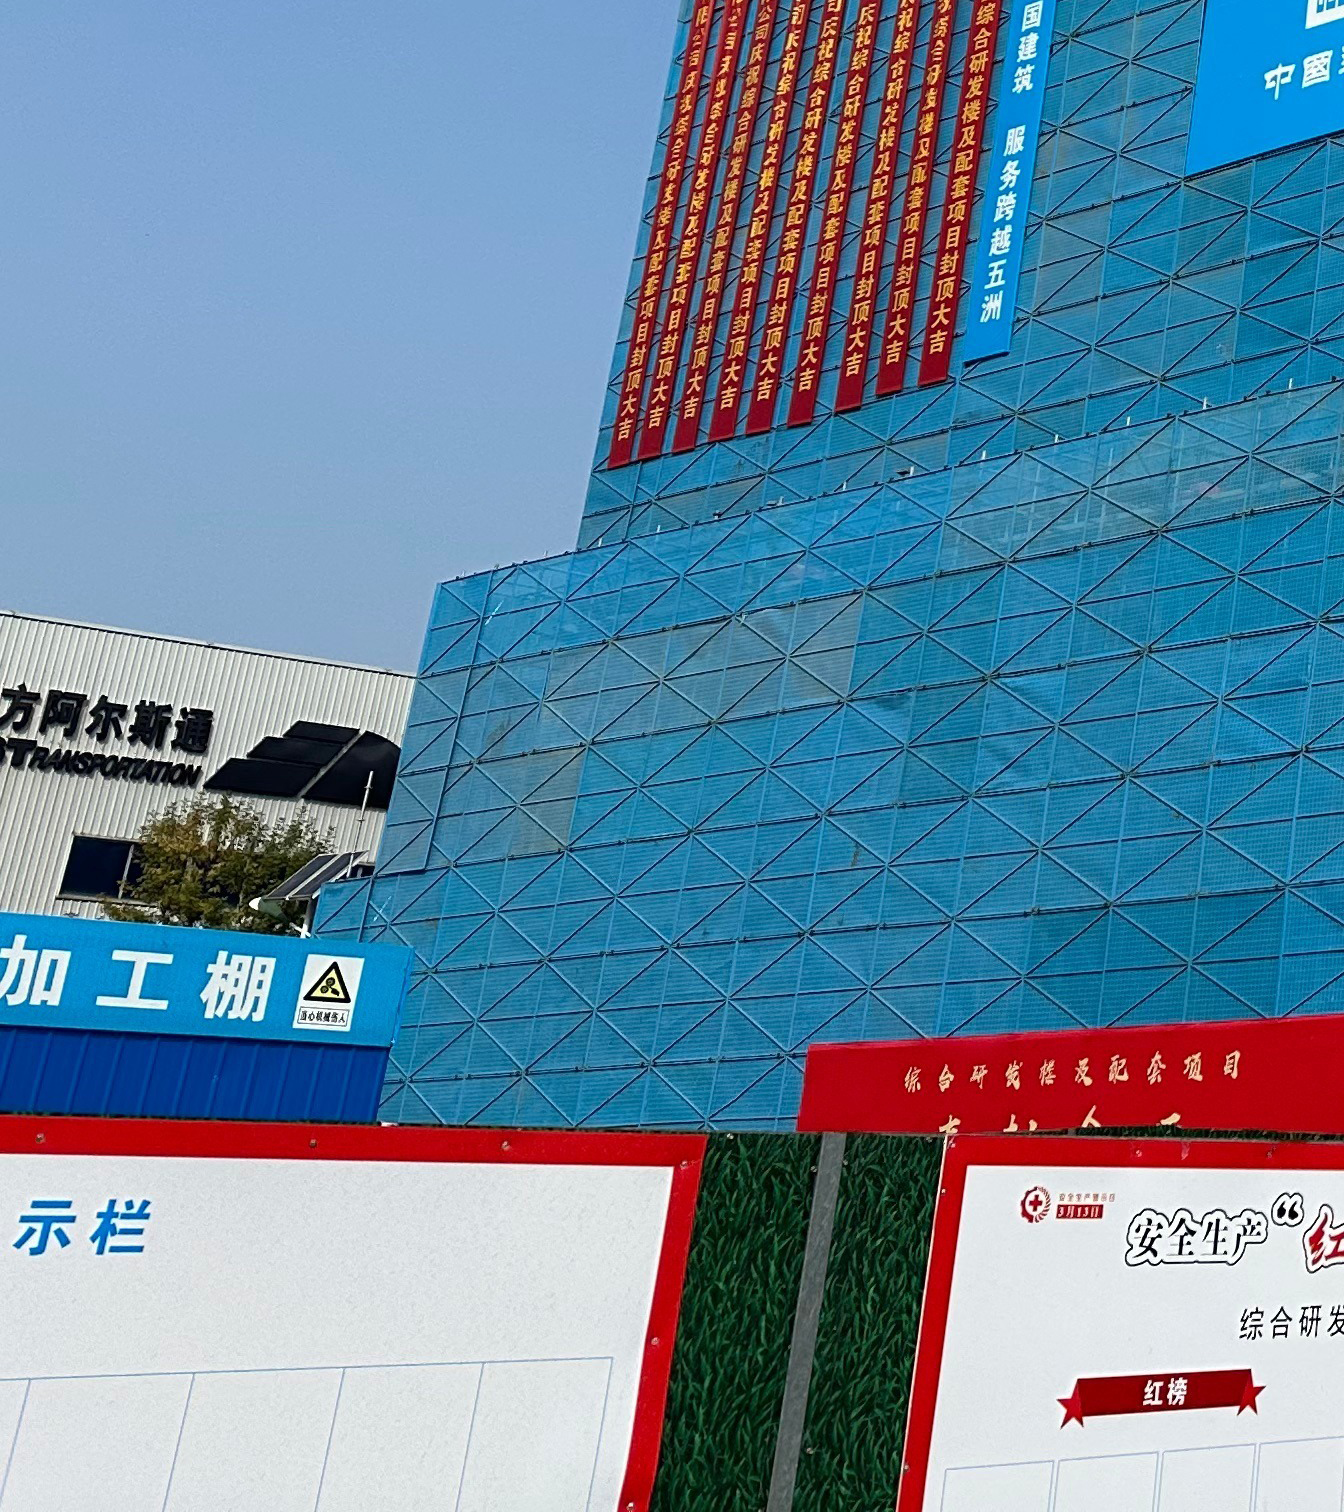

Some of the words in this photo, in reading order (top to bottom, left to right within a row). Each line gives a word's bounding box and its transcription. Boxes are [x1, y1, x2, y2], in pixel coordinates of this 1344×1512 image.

[979, 124, 1027, 322] 服务跨越五洲
[0, 682, 214, 754] 方阿尔斯通
[0, 934, 277, 1022] 加工棚
[13, 1197, 153, 1257] 示栏
[1143, 1377, 1189, 1407] 红榜
